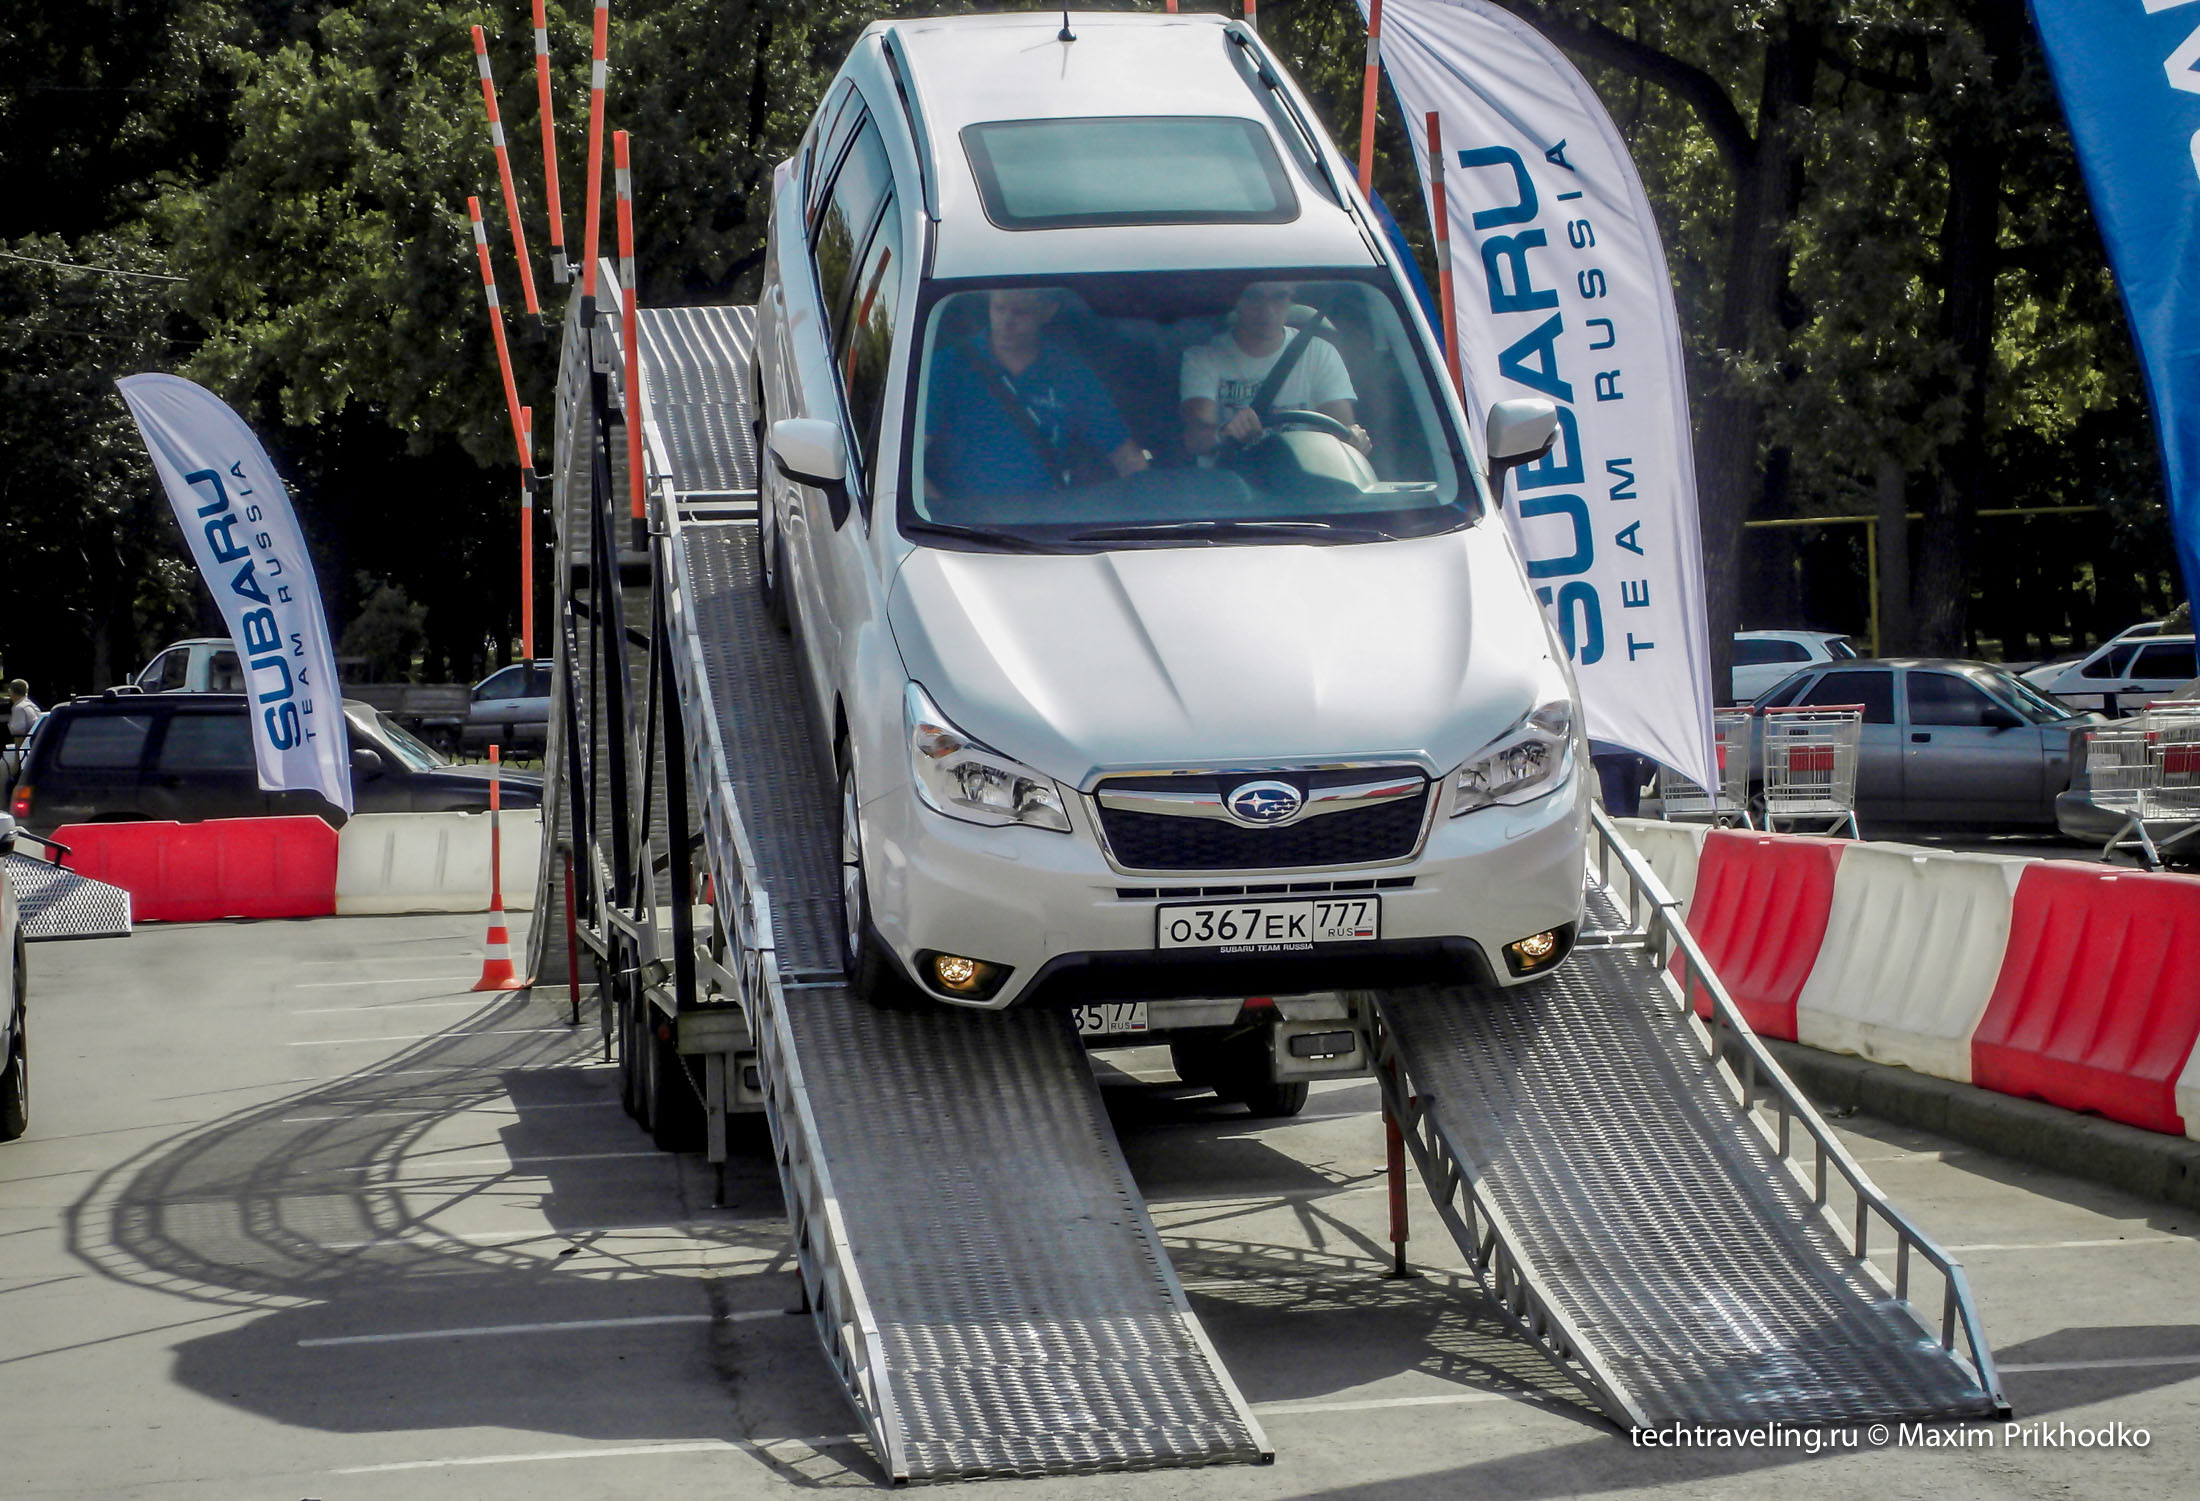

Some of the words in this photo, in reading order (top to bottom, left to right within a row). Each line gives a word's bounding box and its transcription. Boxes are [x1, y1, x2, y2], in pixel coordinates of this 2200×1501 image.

[1545, 139, 1624, 402] RUSSIA
[230, 460, 292, 604] RUSSIA
[1605, 457, 1654, 661] TEAM
[185, 468, 301, 751] SUBARU
[293, 632, 317, 743] TEAM
[1170, 908, 1306, 942] O367EK
[1316, 902, 1367, 927] 777
[1220, 944, 1255, 953] SUBARU
[1257, 943, 1280, 951] TEAM
[1283, 942, 1314, 950] RUSSIA
[1328, 927, 1353, 937] RUS
[1110, 1021, 1131, 1030] RUS
